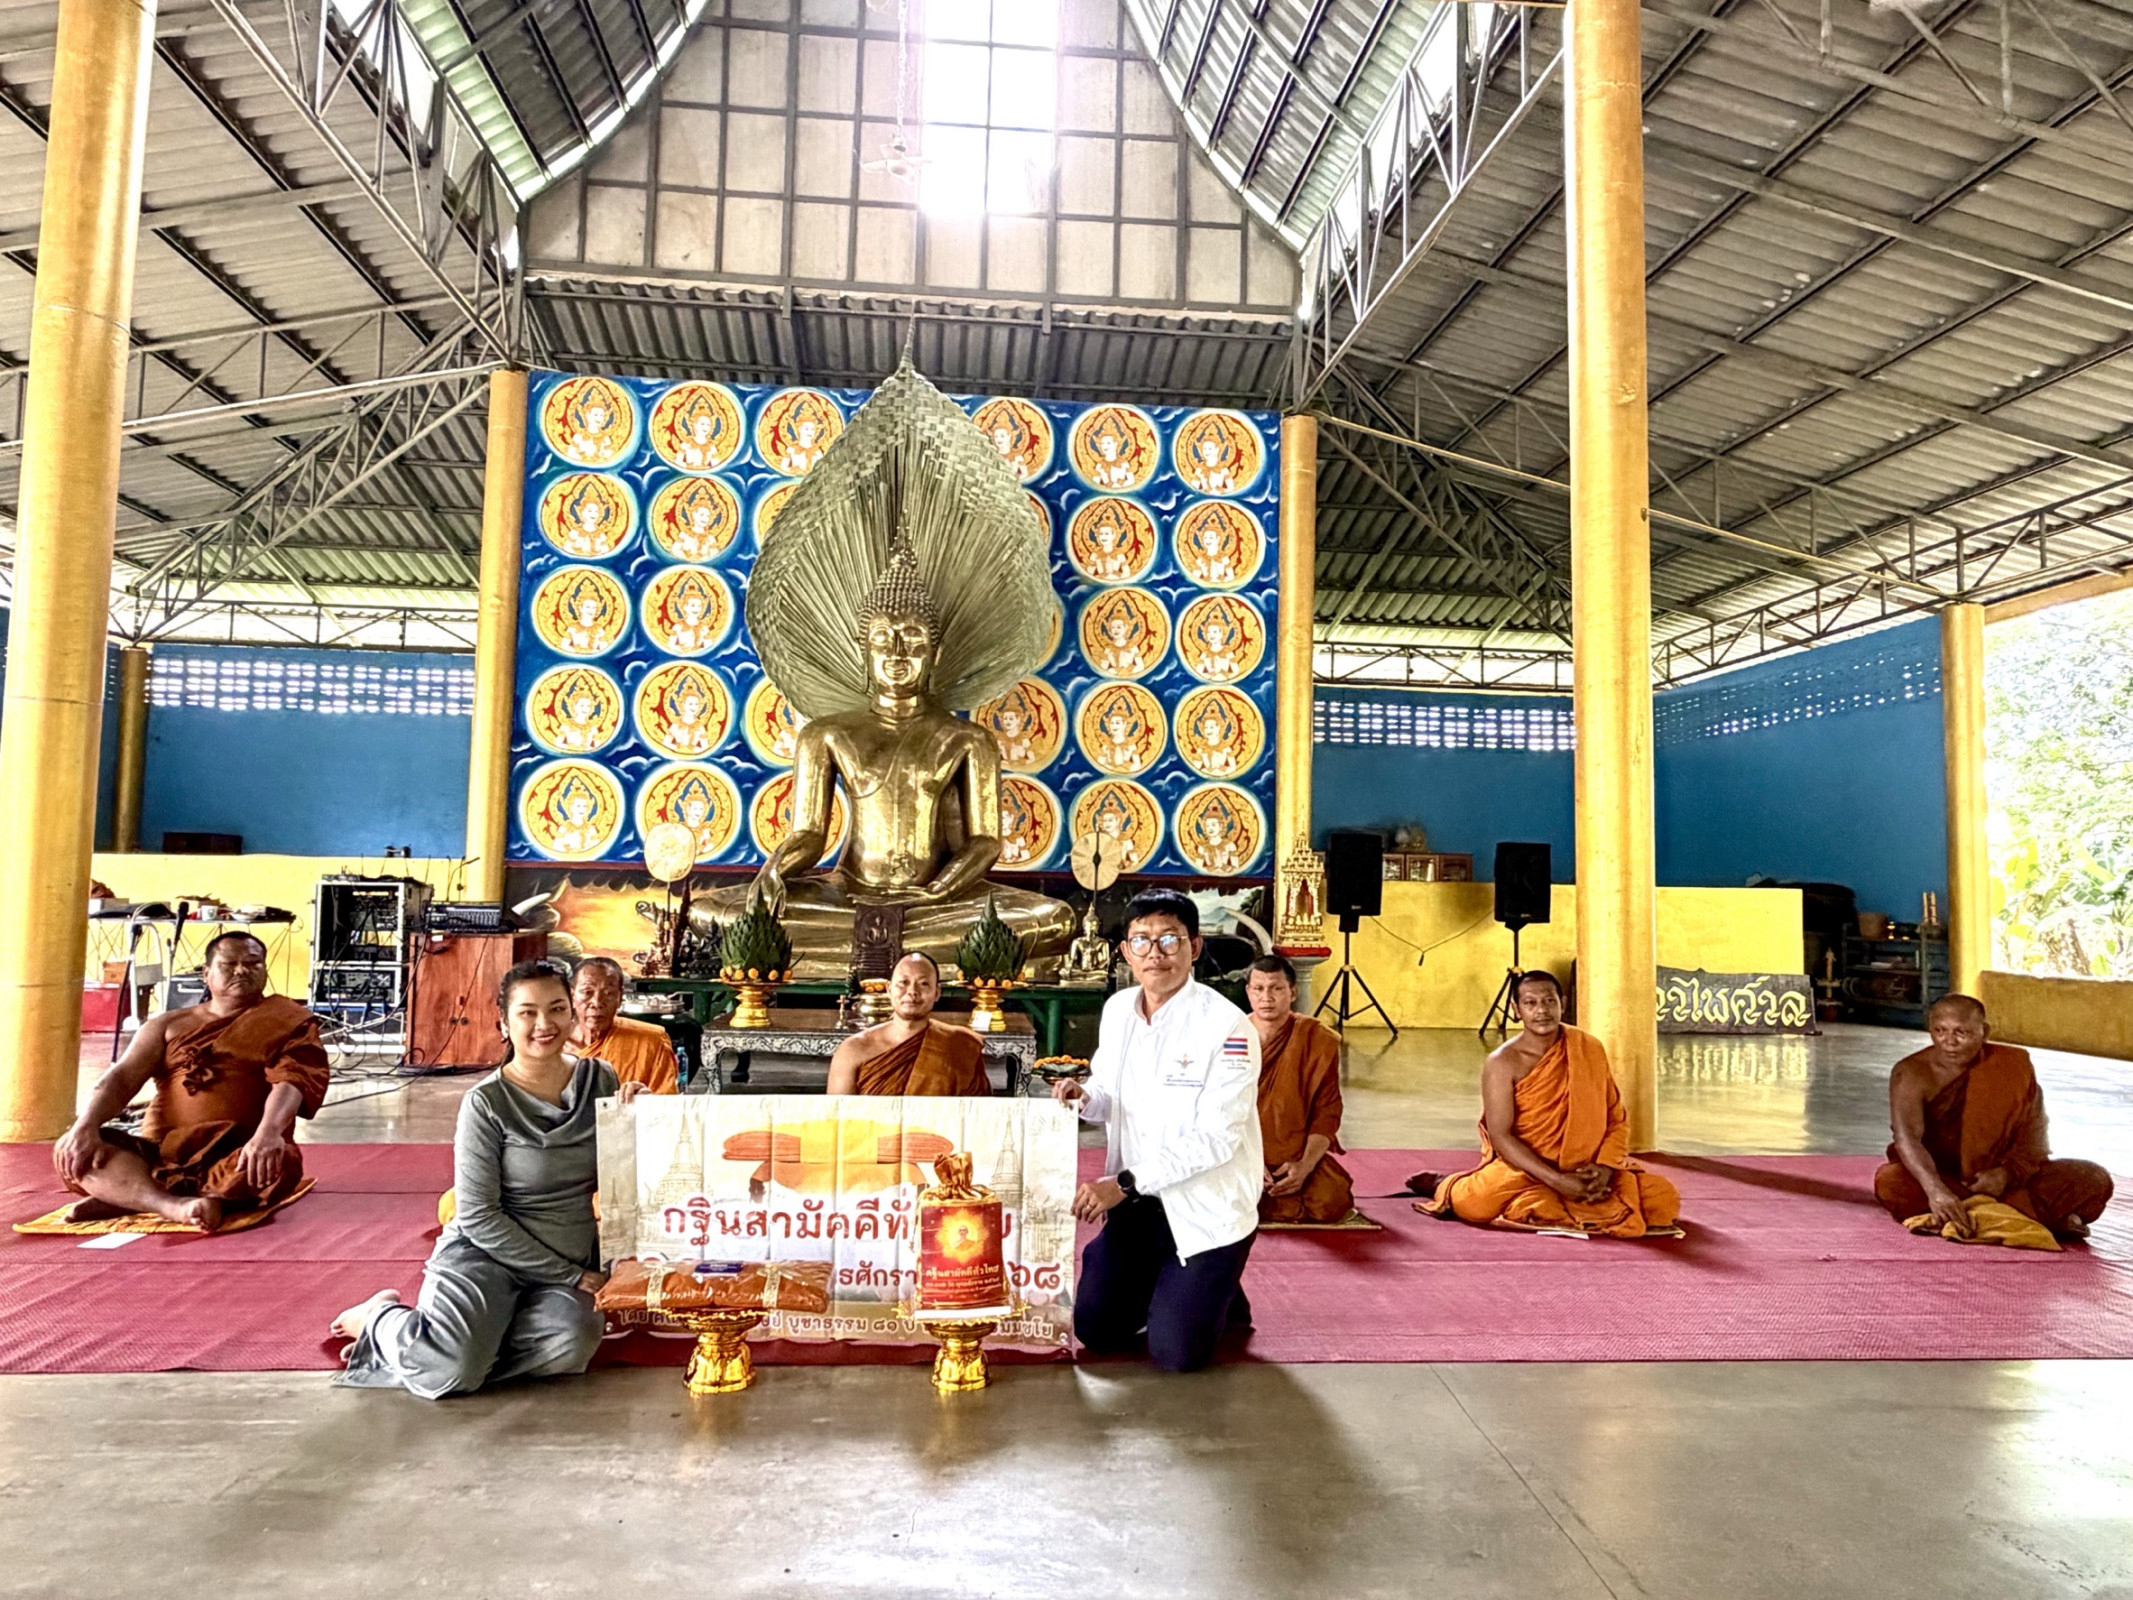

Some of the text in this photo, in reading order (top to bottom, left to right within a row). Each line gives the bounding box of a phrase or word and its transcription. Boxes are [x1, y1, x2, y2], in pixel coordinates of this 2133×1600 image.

[1007, 1261, 1061, 1290] ๖๘
[788, 1316, 867, 1334] บูชาธรรม
